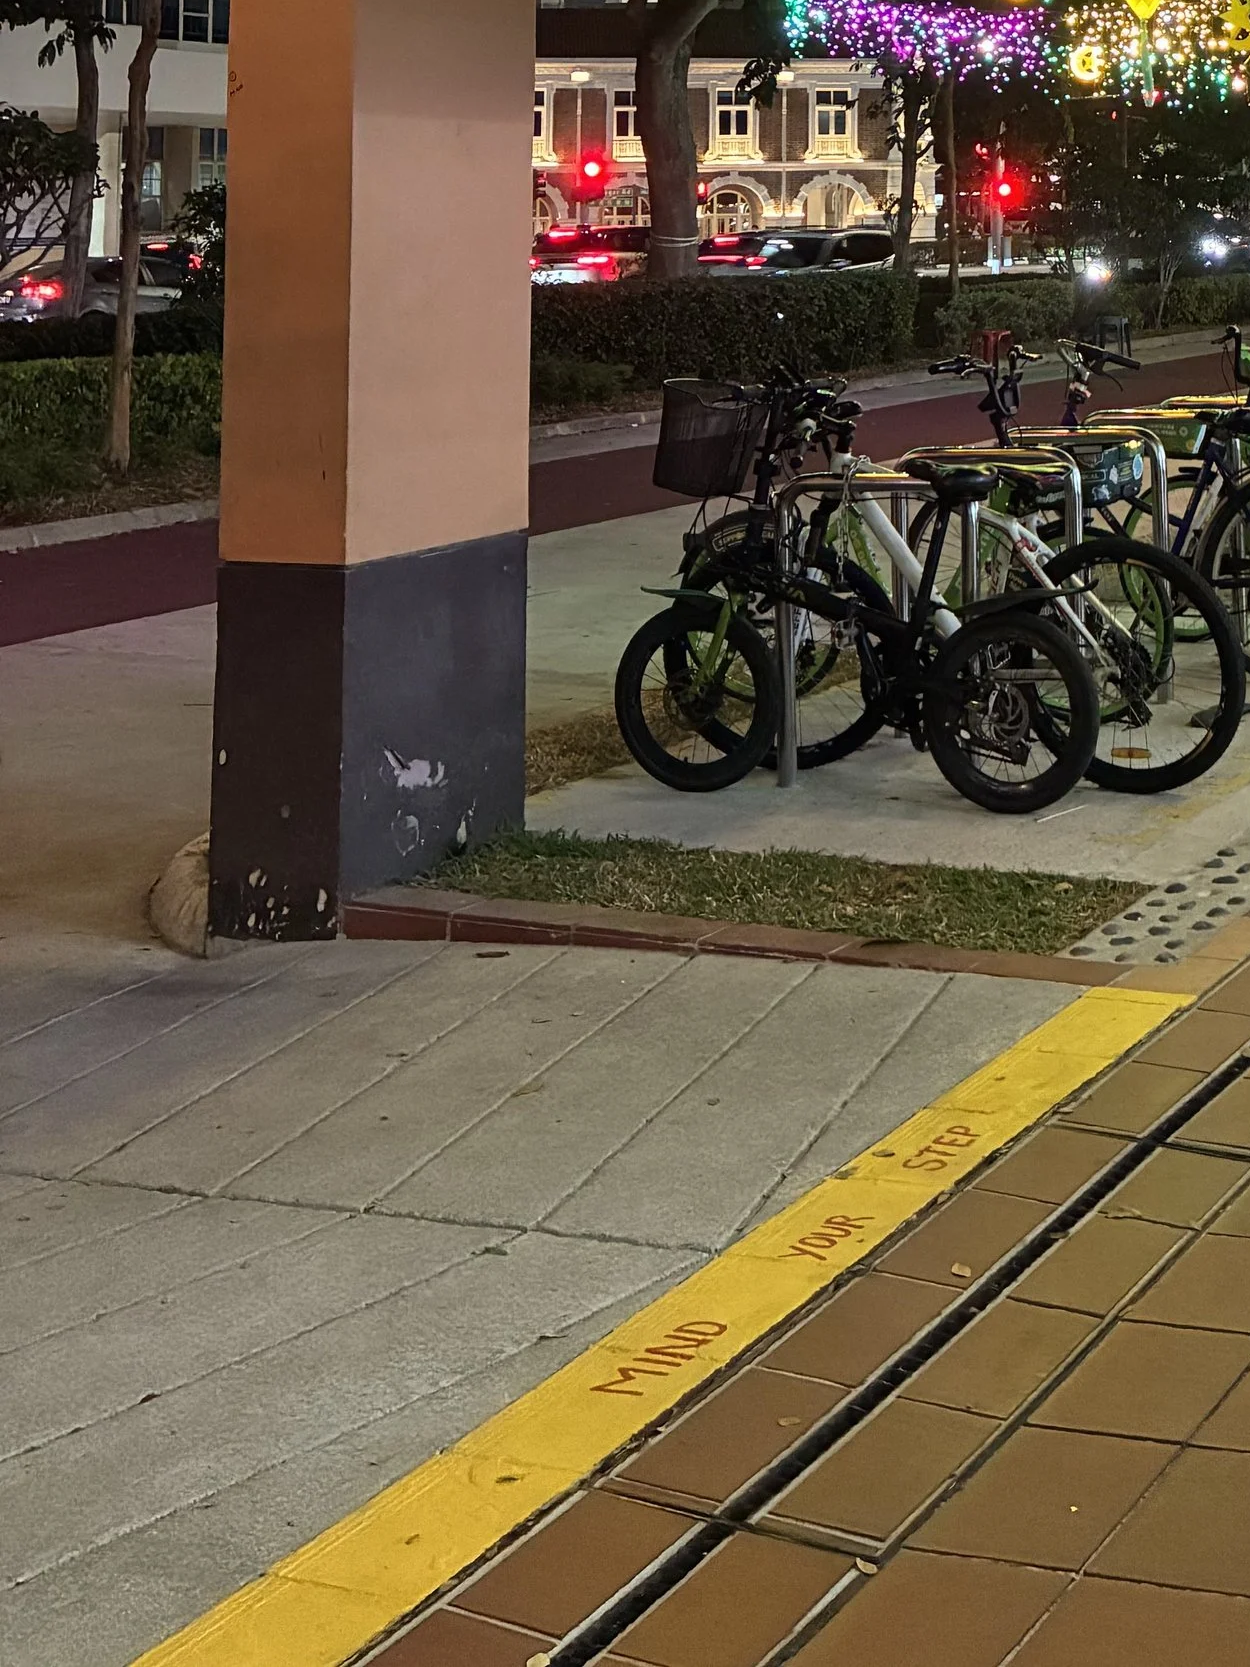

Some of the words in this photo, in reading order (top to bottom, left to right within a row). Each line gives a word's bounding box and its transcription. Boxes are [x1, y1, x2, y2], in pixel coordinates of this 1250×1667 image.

[590, 1321, 728, 1396] MIND
[778, 1214, 875, 1261] YOUR
[902, 1125, 982, 1171] STEP
